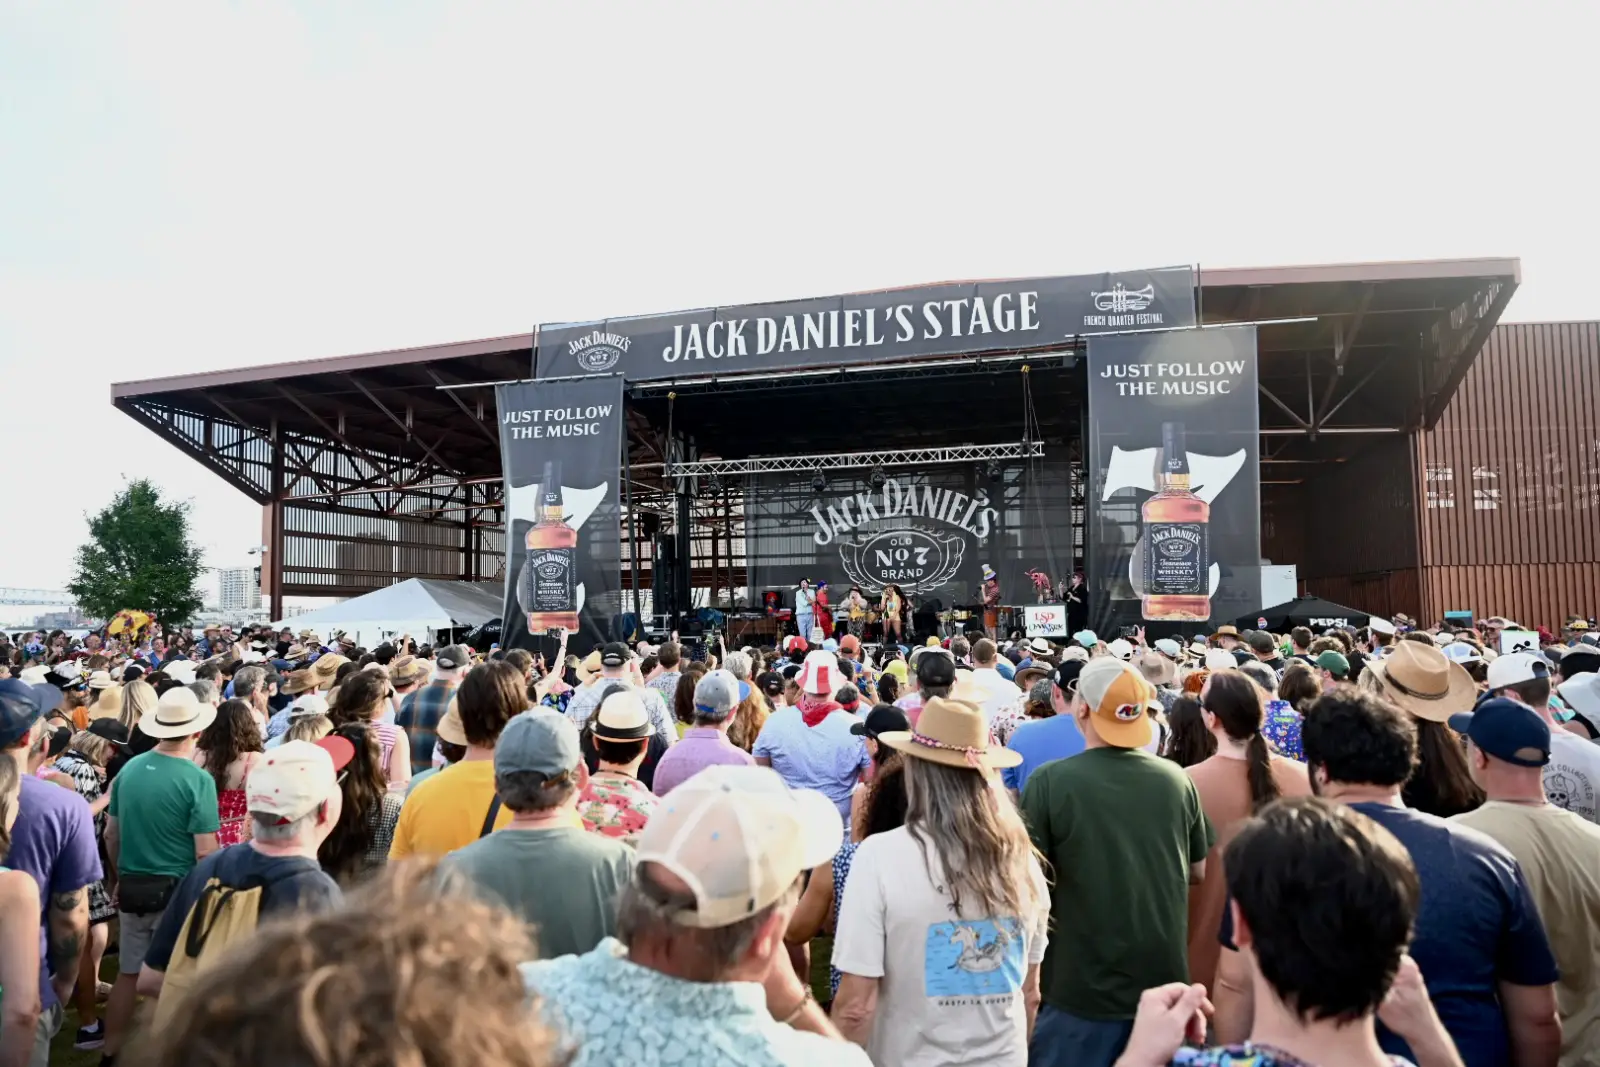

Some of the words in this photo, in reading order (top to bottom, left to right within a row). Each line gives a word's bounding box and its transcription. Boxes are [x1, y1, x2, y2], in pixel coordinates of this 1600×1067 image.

[662, 319, 748, 362] JACK
[756, 303, 915, 354] DANIEL'S
[923, 291, 1040, 340] STAGE
[1083, 315, 1106, 326] FRENCH
[1107, 314, 1135, 327] QUARTER
[1136, 312, 1164, 325] FESTIVAL
[569, 334, 593, 355] JACK
[592, 330, 632, 353] DANIEL'S
[1100, 363, 1153, 378] JUST
[1157, 360, 1245, 377] FOLLOW
[1116, 381, 1157, 396] THE
[1162, 379, 1231, 396] MUSIC
[502, 410, 541, 425] JUST
[544, 404, 613, 422] FOLLOW
[511, 426, 543, 440] THE
[546, 422, 600, 438] MUSIC
[809, 489, 880, 546] JACK
[882, 478, 999, 539] DANIEL'S
[890, 537, 912, 546] OLD
[1151, 530, 1171, 544] JACK
[1170, 527, 1201, 545] DANIEL'S
[532, 554, 547, 568] JACK
[546, 552, 571, 567] DANIEL'S
[881, 568, 923, 579] BRAND
[1308, 617, 1348, 628] PEPSI
